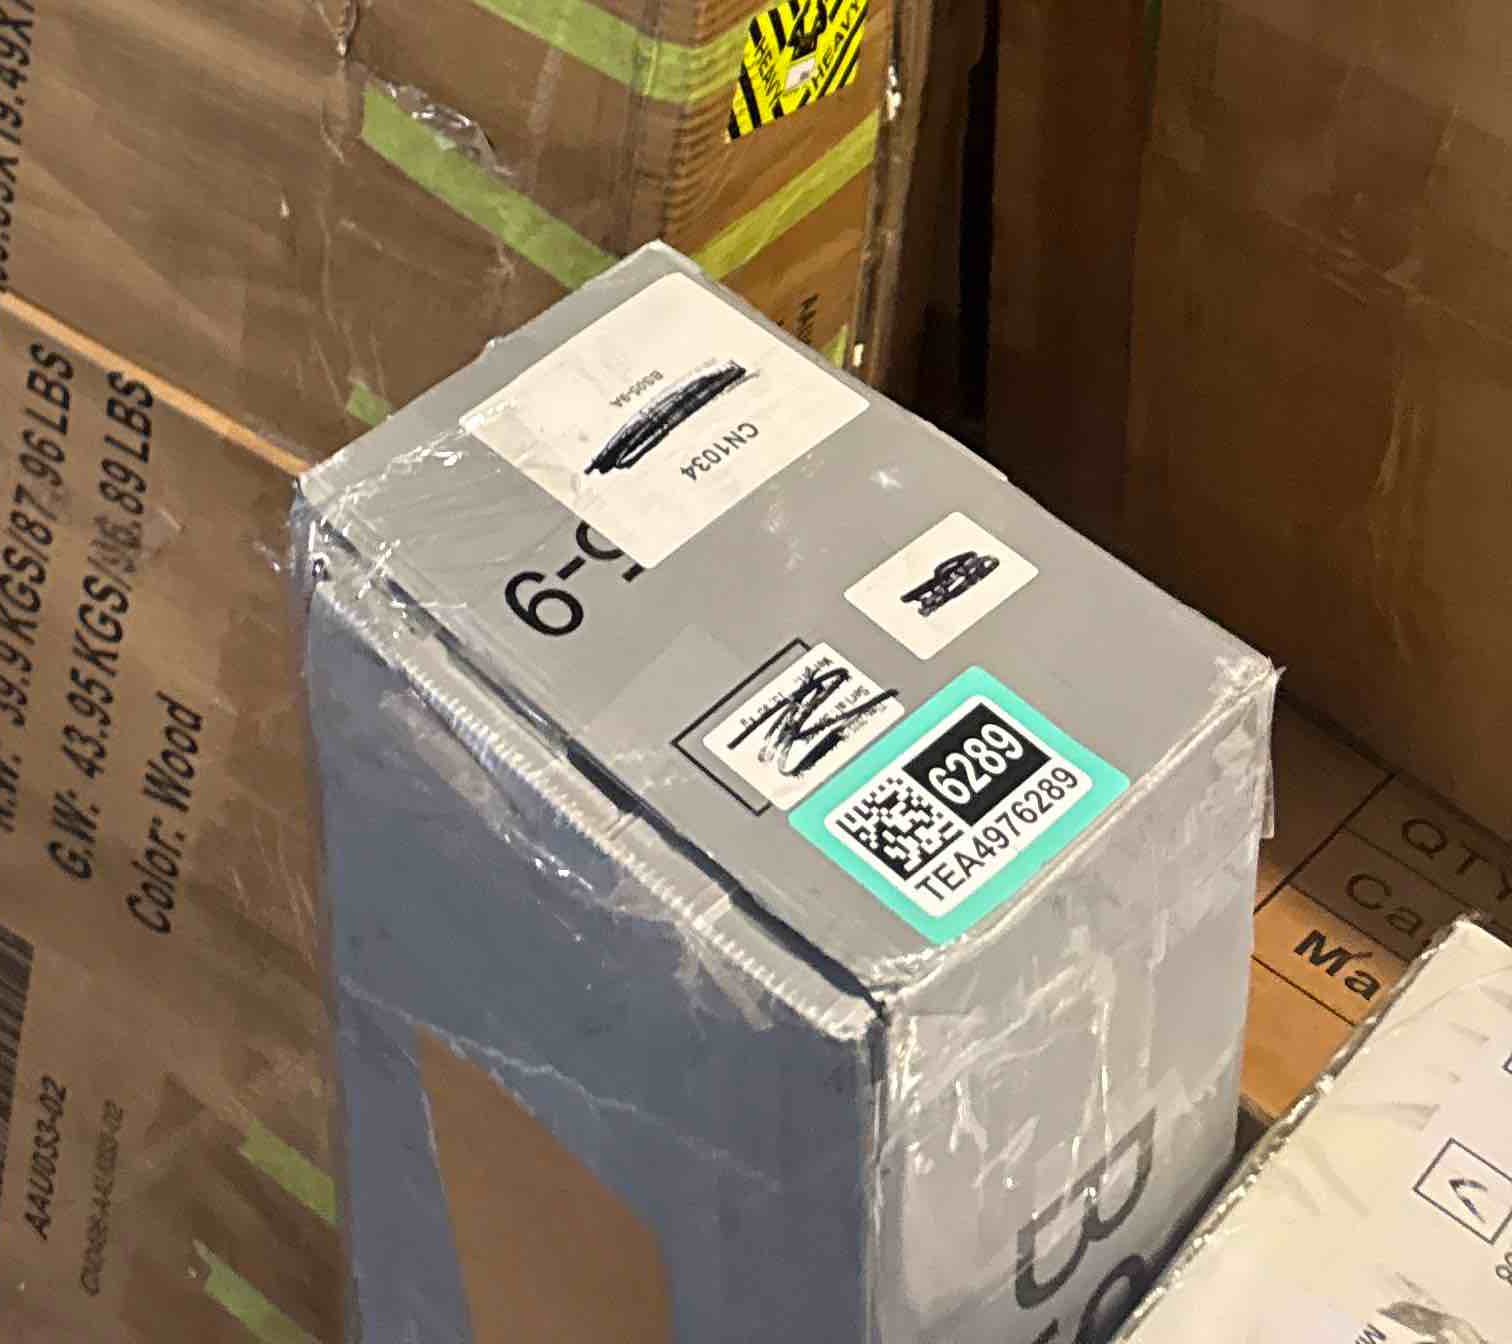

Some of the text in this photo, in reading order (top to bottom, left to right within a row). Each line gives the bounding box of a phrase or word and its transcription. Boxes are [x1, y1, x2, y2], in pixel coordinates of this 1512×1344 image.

[679, 421, 760, 481] CN1034
[128, 700, 204, 936] Color: Wood
[926, 721, 1025, 805] 6289
[914, 766, 1078, 903] TEA4976289
[24, 1074, 67, 1241] AAU033-02
